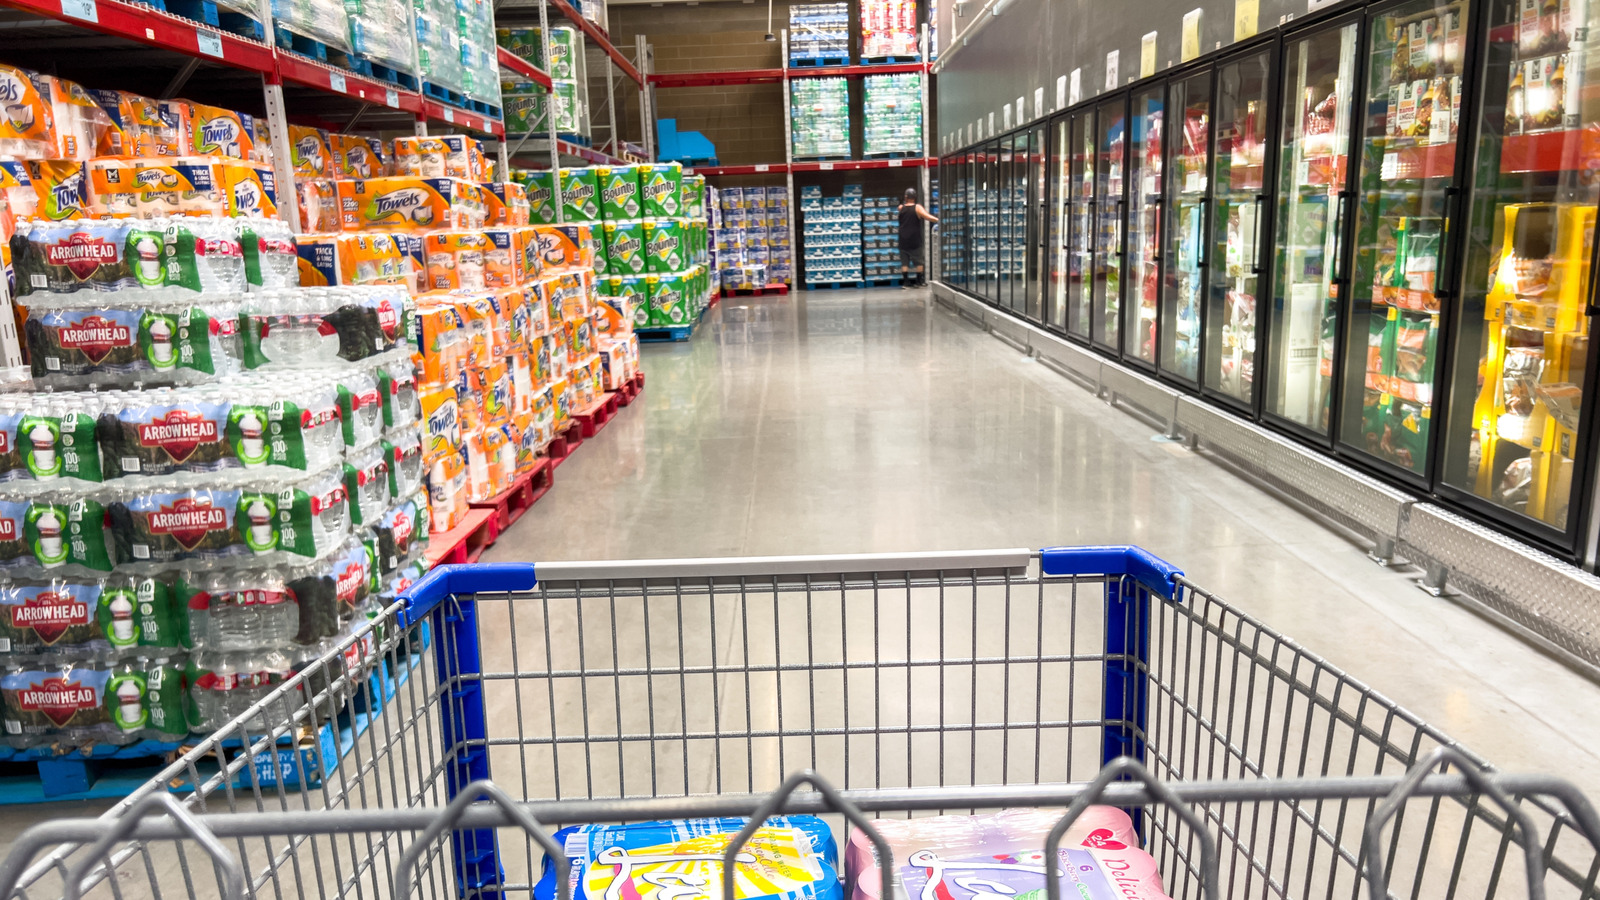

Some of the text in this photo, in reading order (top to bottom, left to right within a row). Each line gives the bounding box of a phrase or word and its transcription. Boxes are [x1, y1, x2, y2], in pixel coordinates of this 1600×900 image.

[506, 97, 537, 116] Bounty
[201, 123, 233, 148] Towels
[136, 170, 161, 184] Towels
[561, 184, 595, 206] Bounty
[602, 182, 636, 204] Bounty
[643, 181, 676, 201] Bounty
[373, 191, 420, 216] Towels
[345, 213, 354, 223] 15
[50, 244, 115, 261] ARROWHEAD
[315, 247, 333, 256] THICK
[608, 238, 641, 260] Bounty
[647, 236, 679, 257] Bounty
[63, 327, 128, 344] ARROWHEAD
[428, 406, 455, 437] Towels
[144, 422, 214, 441] ARROWHEAD
[153, 509, 224, 528] ARROWHEAD
[16, 604, 86, 622] ARROWHEAD
[24, 688, 93, 705] ARROWHEAD
[1091, 834, 1108, 847] 24
[1079, 864, 1094, 872] 6
